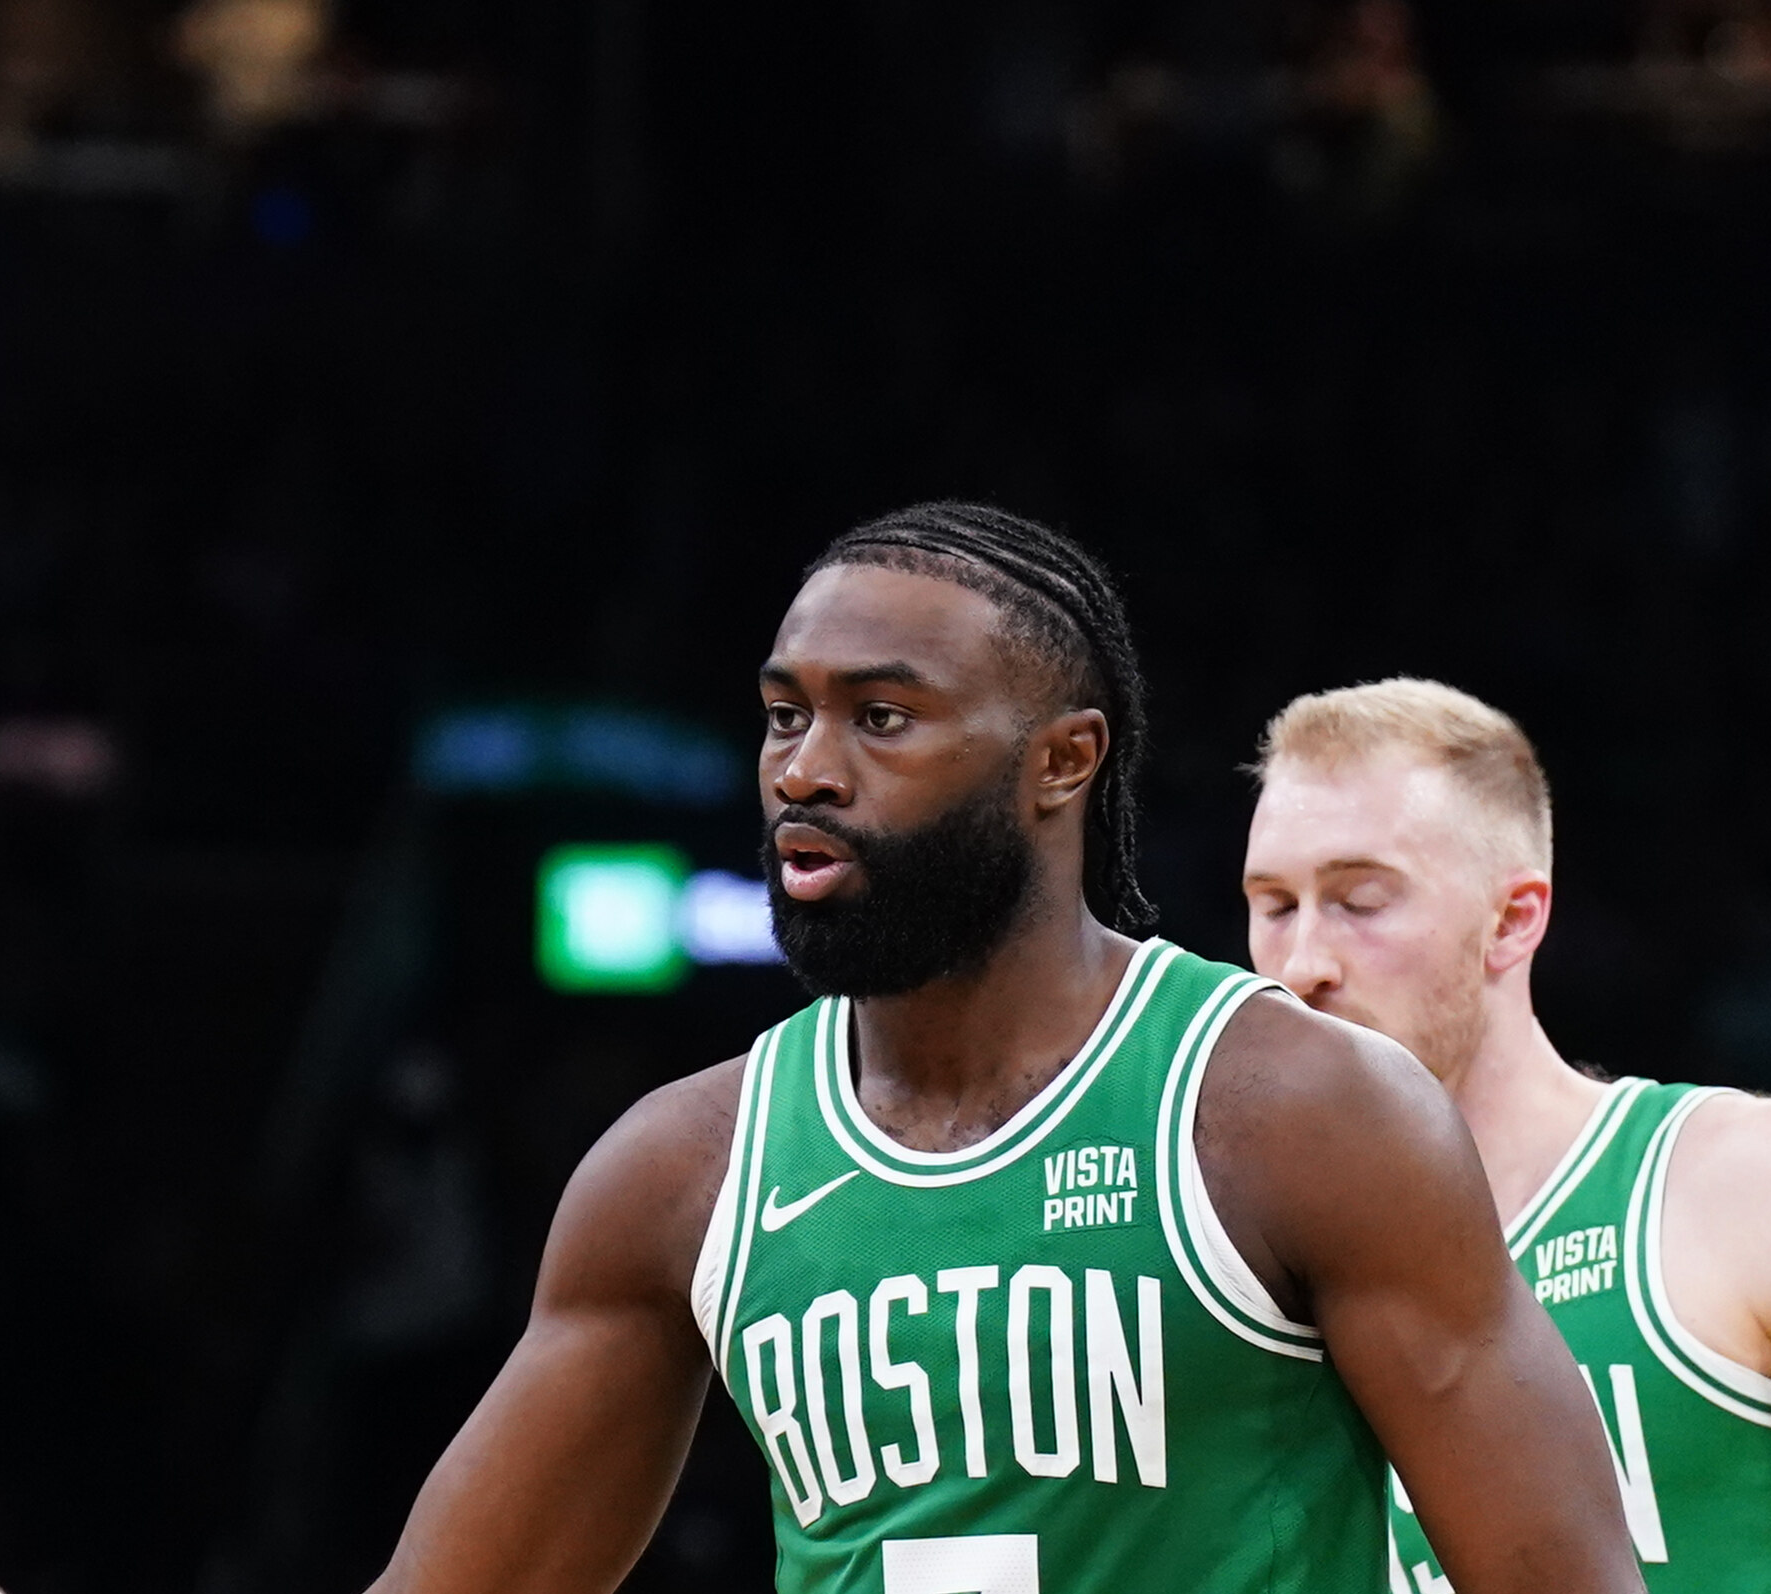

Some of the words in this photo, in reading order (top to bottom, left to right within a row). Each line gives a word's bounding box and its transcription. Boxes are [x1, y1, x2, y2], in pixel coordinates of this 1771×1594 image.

[1044, 1146, 1138, 1196] VISTA
[1043, 1190, 1138, 1232] PRINT
[1535, 1225, 1617, 1279] VISTA
[1534, 1260, 1617, 1306] PRINT
[742, 1264, 1167, 1529] BOSTON
